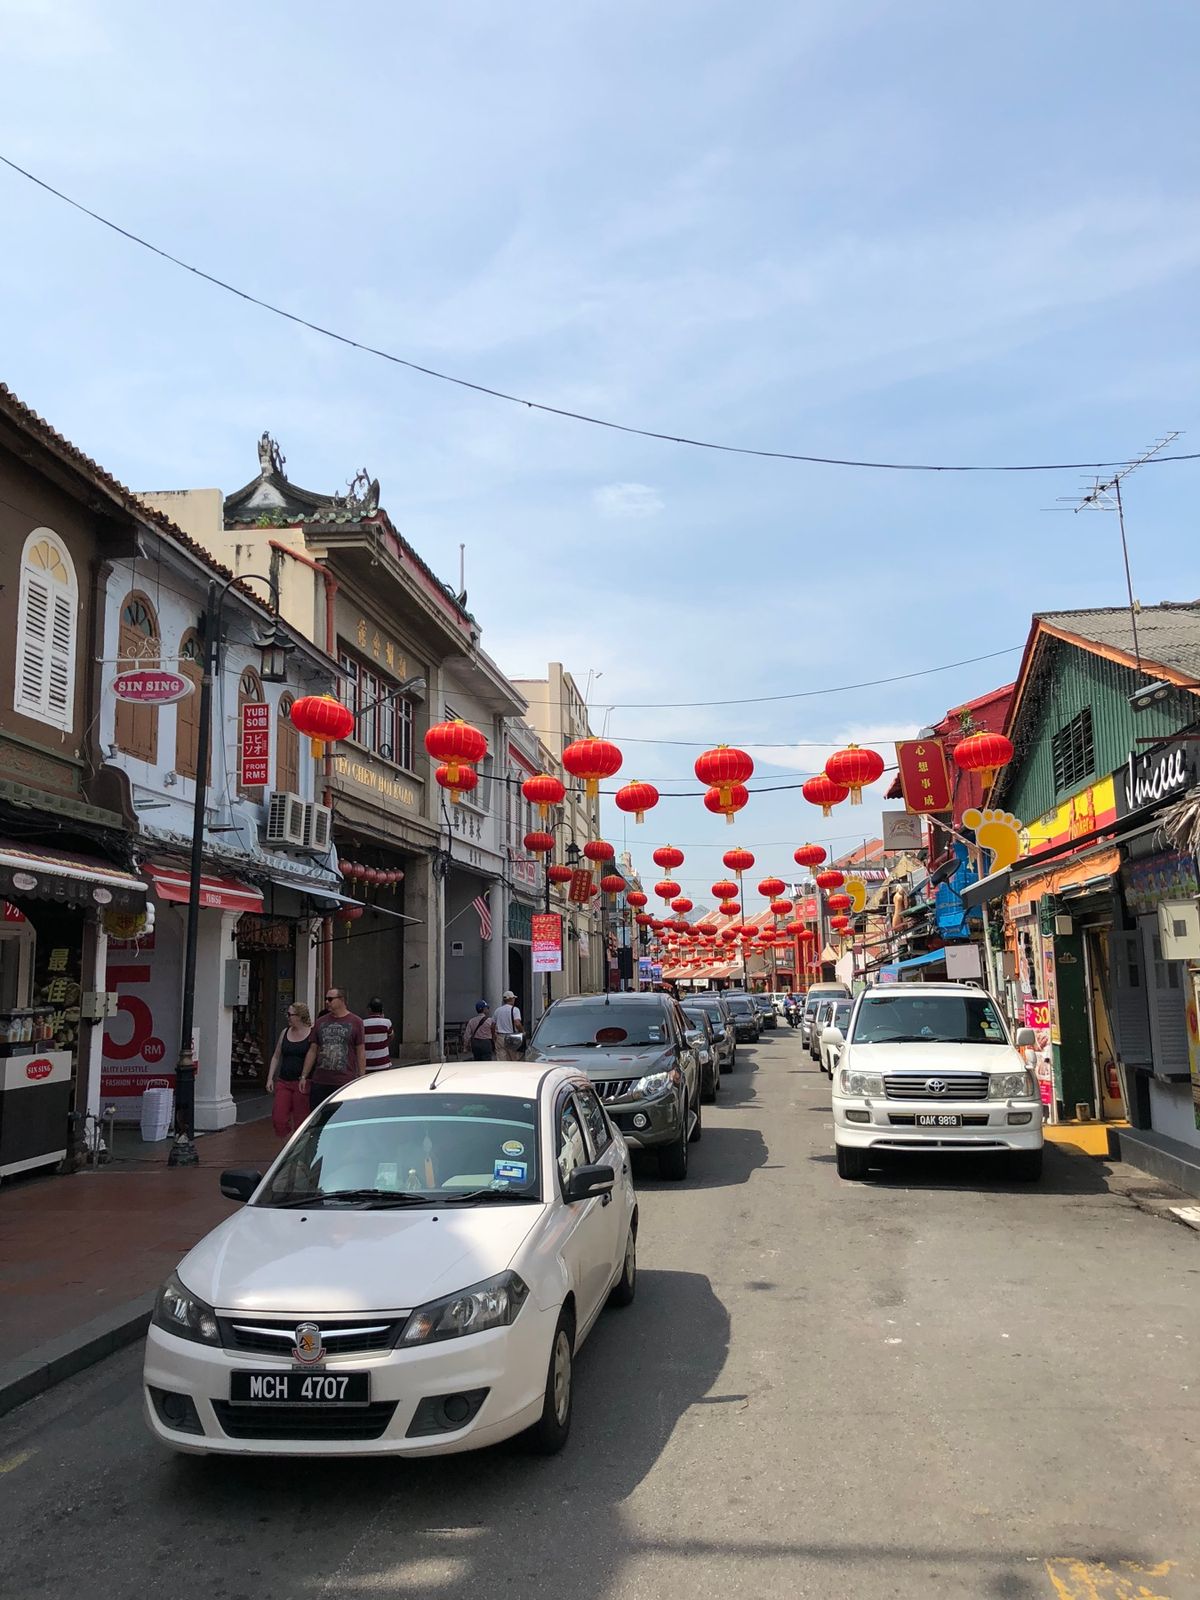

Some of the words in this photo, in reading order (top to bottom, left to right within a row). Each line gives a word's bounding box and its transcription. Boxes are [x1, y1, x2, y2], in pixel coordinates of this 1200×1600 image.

[118, 681, 143, 692] SIN
[145, 680, 180, 692] SING
[246, 707, 268, 717] YUBI
[246, 718, 258, 727] SO
[245, 734, 263, 744] ユビ
[245, 745, 263, 755] ソオ
[245, 770, 267, 780] RM5
[915, 745, 935, 806] 心想事成
[352, 763, 377, 788] CHEW
[378, 775, 393, 796] HUI
[393, 782, 414, 806] KUAN
[102, 965, 153, 1060] 5
[1033, 1006, 1049, 1024] 30
[144, 1044, 162, 1055] RM
[27, 1067, 38, 1075] SIN
[38, 1064, 52, 1073] SING
[101, 1065, 119, 1073] ALITY
[120, 1065, 149, 1073] LIFESTYLE
[105, 1079, 131, 1087] FASHION
[938, 1115, 957, 1125] 9819
[250, 1375, 288, 1399] MCH
[301, 1376, 349, 1399] 4707
